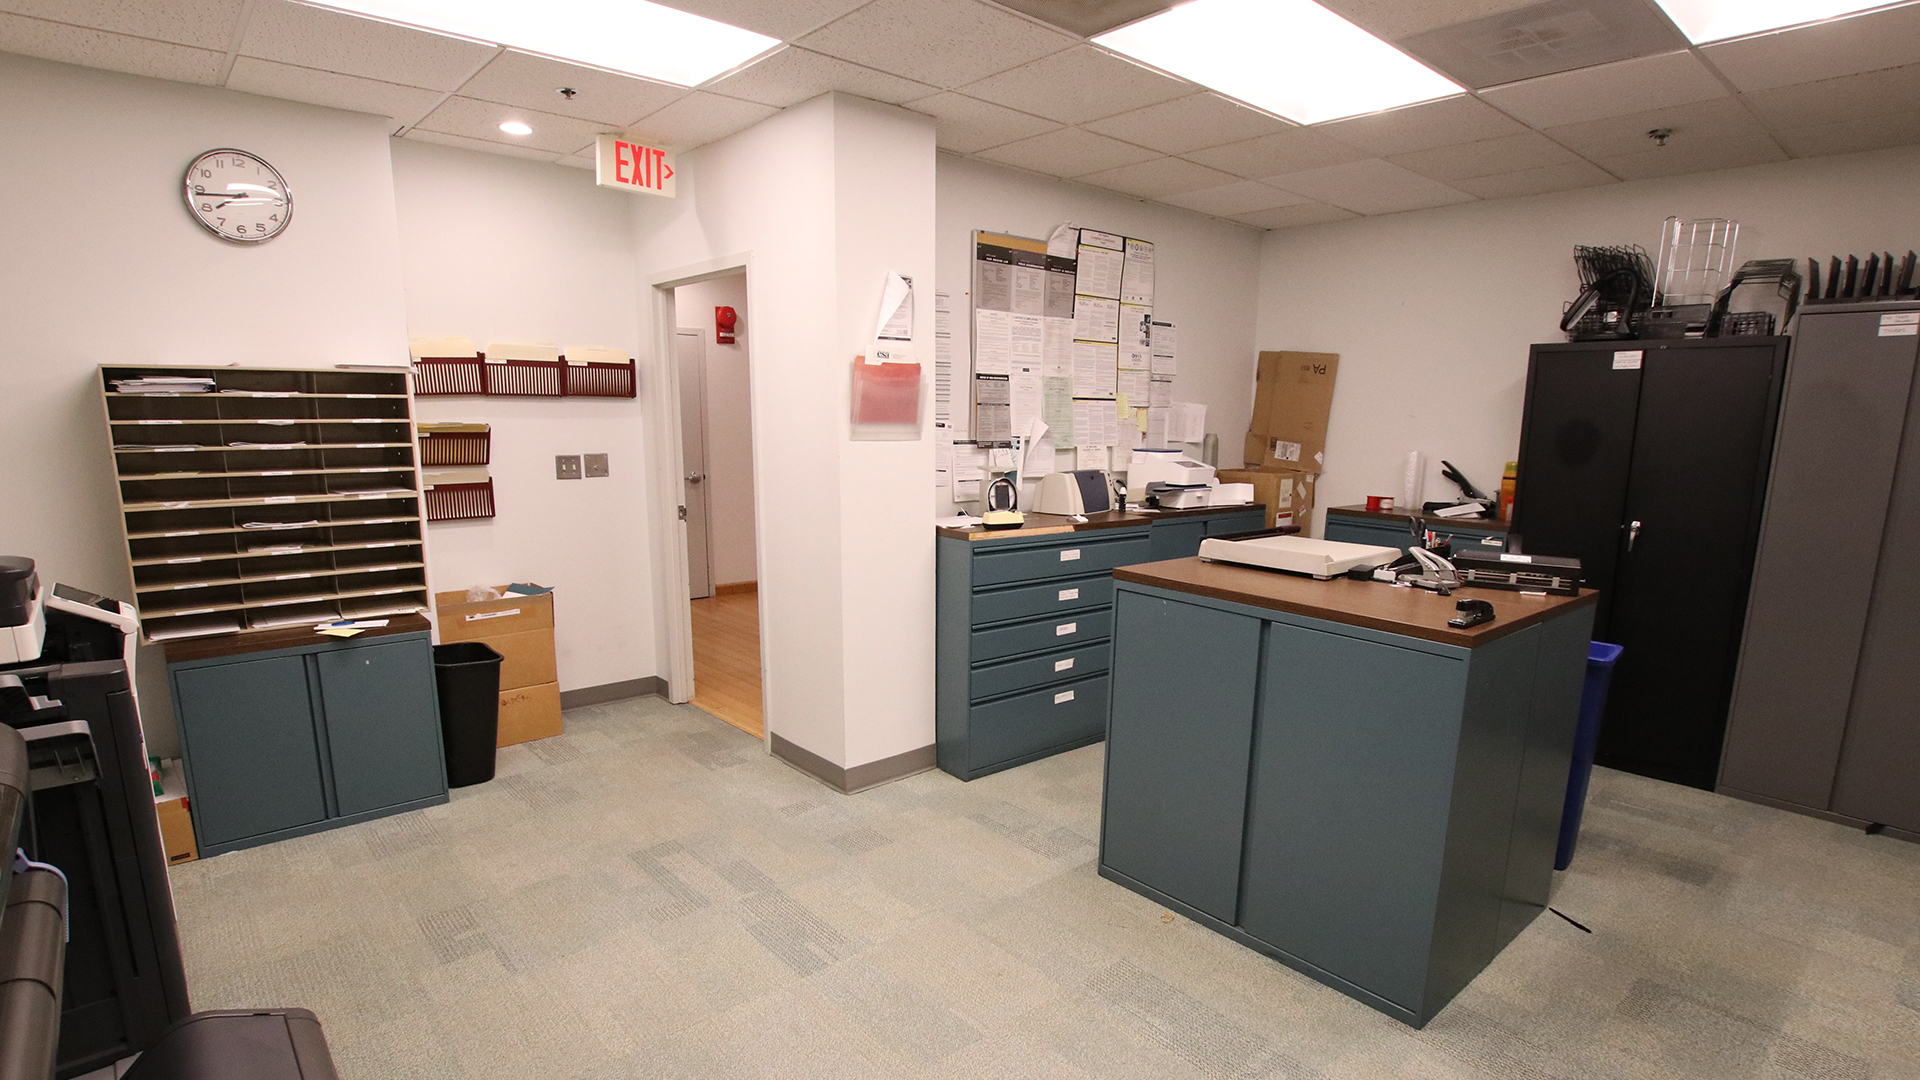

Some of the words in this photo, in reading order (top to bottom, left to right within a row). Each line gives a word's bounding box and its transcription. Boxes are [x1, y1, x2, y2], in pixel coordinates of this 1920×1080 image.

[216, 159, 223, 168] 11
[232, 158, 245, 168] 12
[615, 140, 665, 191] EXIT
[201, 169, 211, 178] 10
[194, 185, 205, 194] 9
[267, 181, 277, 190] 2
[273, 197, 284, 207] 3
[201, 203, 213, 212] 8
[216, 217, 226, 226] 7
[269, 214, 278, 222] 4
[236, 225, 246, 234] 6
[256, 223, 266, 232] 5
[1313, 363, 1327, 374] PA
